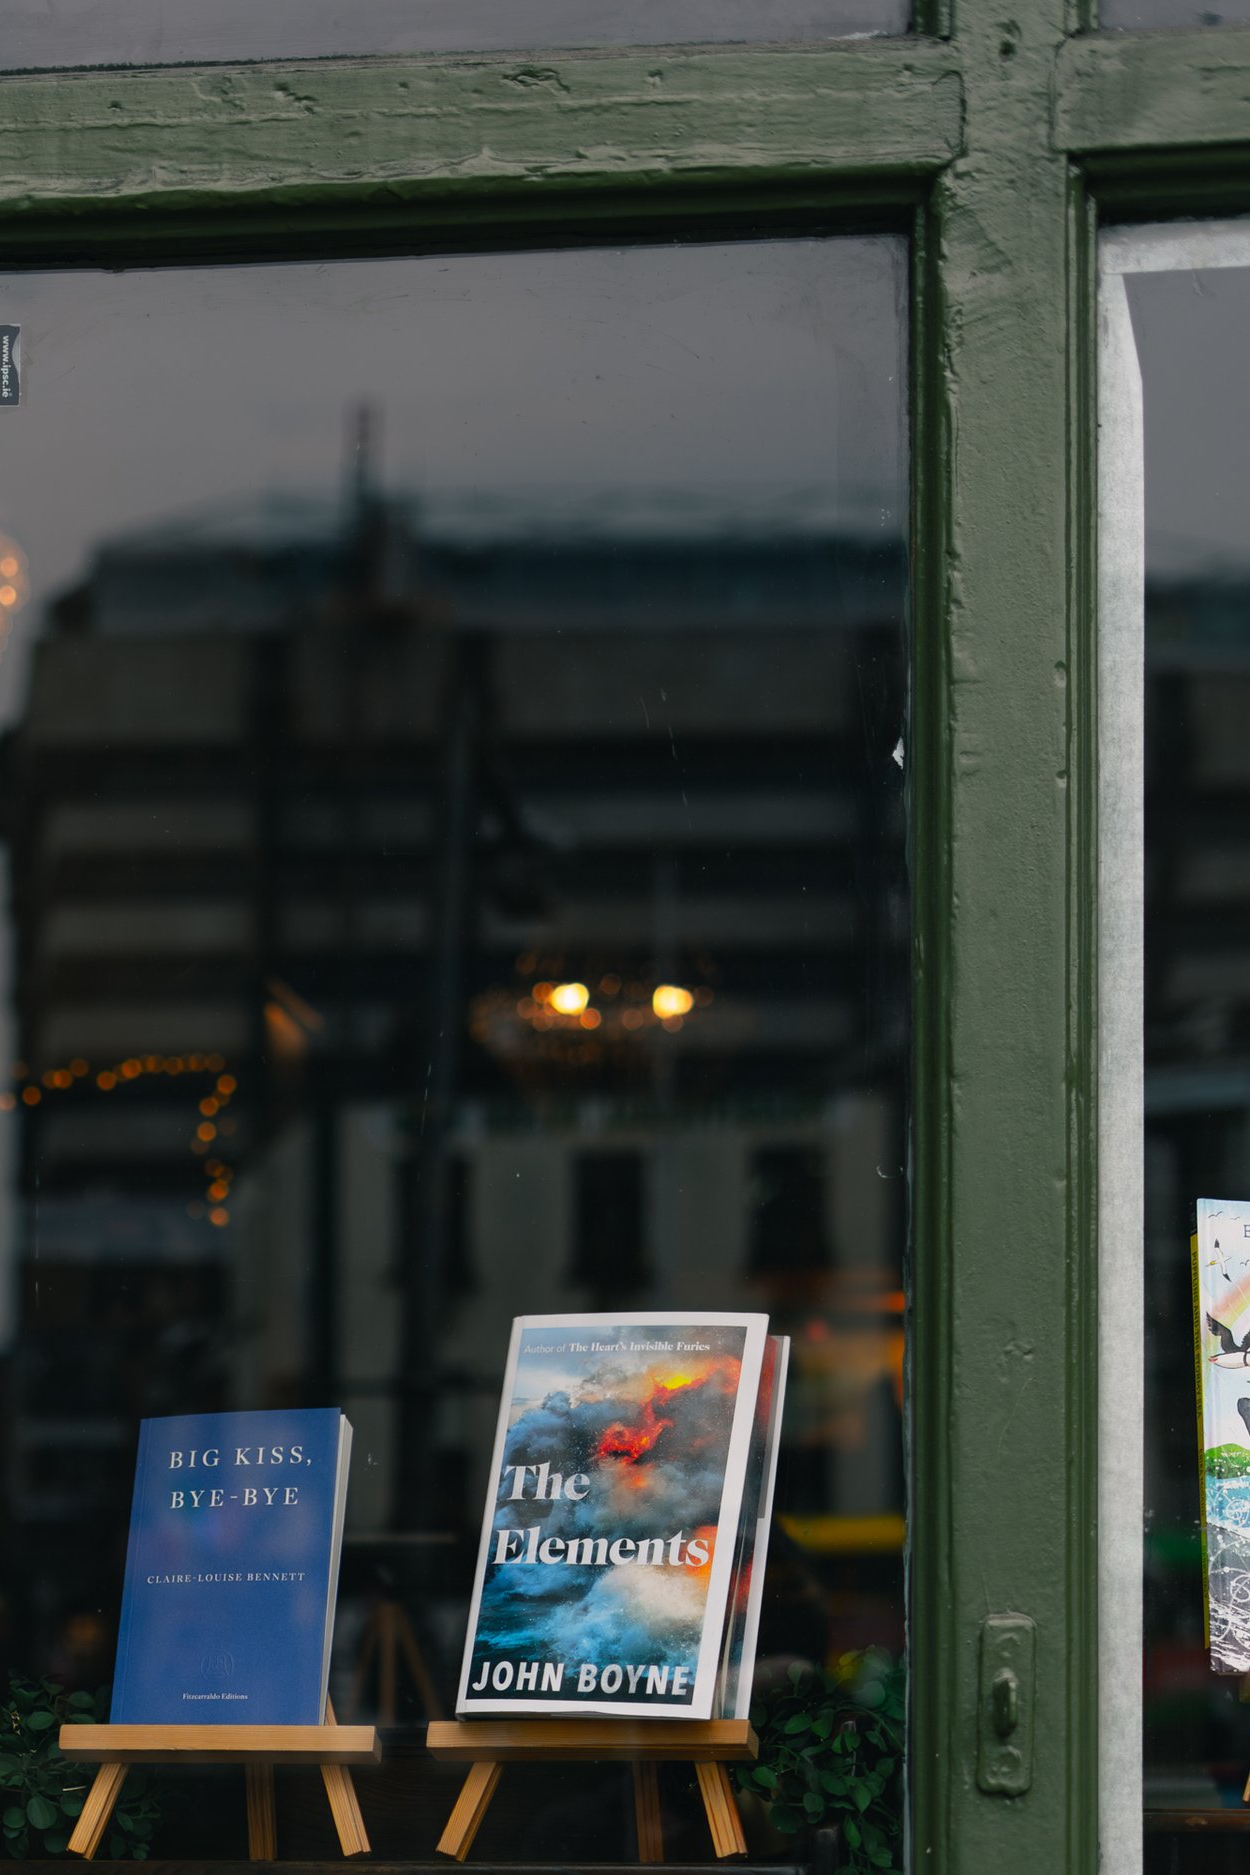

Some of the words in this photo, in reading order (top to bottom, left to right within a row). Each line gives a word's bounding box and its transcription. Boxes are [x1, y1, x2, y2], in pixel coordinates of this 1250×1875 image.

[2, 335, 12, 398] www.ipsc.ie
[525, 1344, 554, 1353] Author
[556, 1344, 566, 1352] of
[569, 1343, 588, 1352] The
[591, 1342, 627, 1351] Heart's
[630, 1341, 673, 1351] Invisible
[676, 1341, 710, 1351] Furies
[169, 1448, 220, 1469] BIG
[234, 1446, 312, 1467] KISS,
[503, 1460, 591, 1501] The
[170, 1487, 299, 1509] BYE-BYE
[491, 1525, 709, 1567] Elements
[147, 1573, 242, 1584] CLAIRE-LOUISE
[247, 1572, 305, 1582] BENNETT
[472, 1660, 564, 1692] JOHN
[577, 1664, 690, 1696] BOYNE
